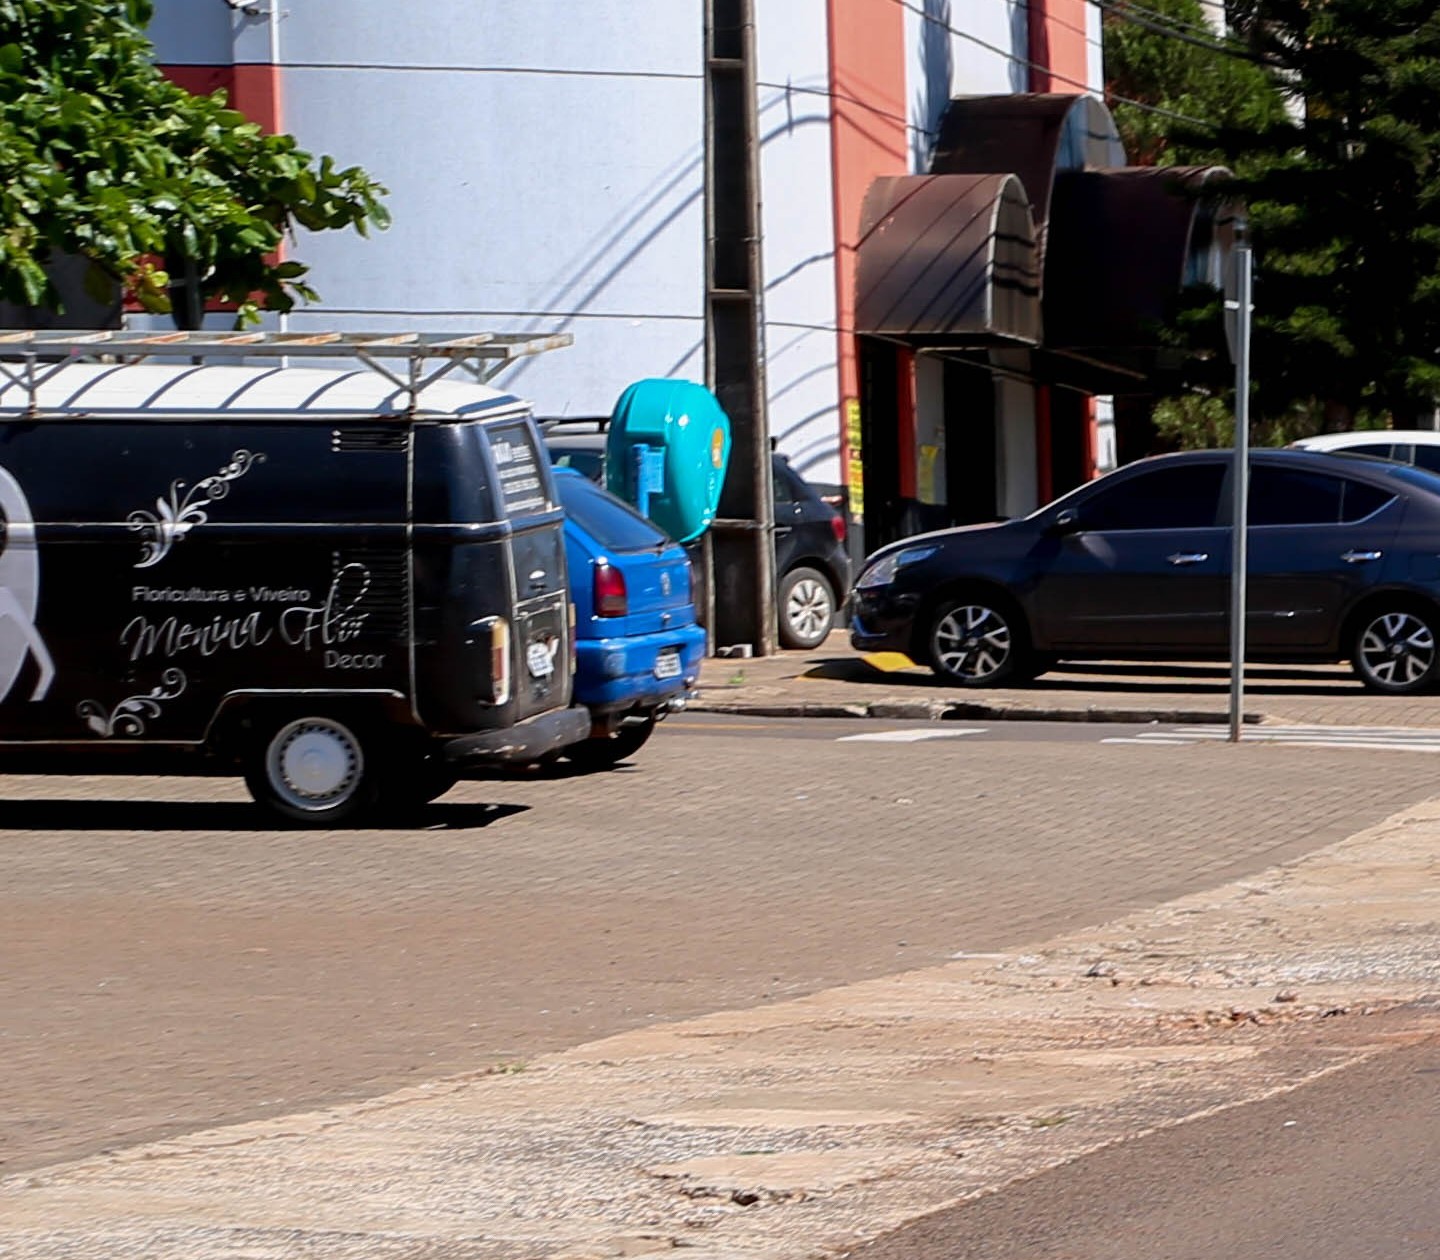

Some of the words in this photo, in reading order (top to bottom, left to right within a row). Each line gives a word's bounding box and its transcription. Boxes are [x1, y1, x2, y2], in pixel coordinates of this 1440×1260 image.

[132, 586, 228, 602] Floricultura
[232, 589, 247, 602] e
[250, 586, 311, 602] Viveiro
[119, 611, 273, 662] Menina
[324, 650, 386, 669] Decor
